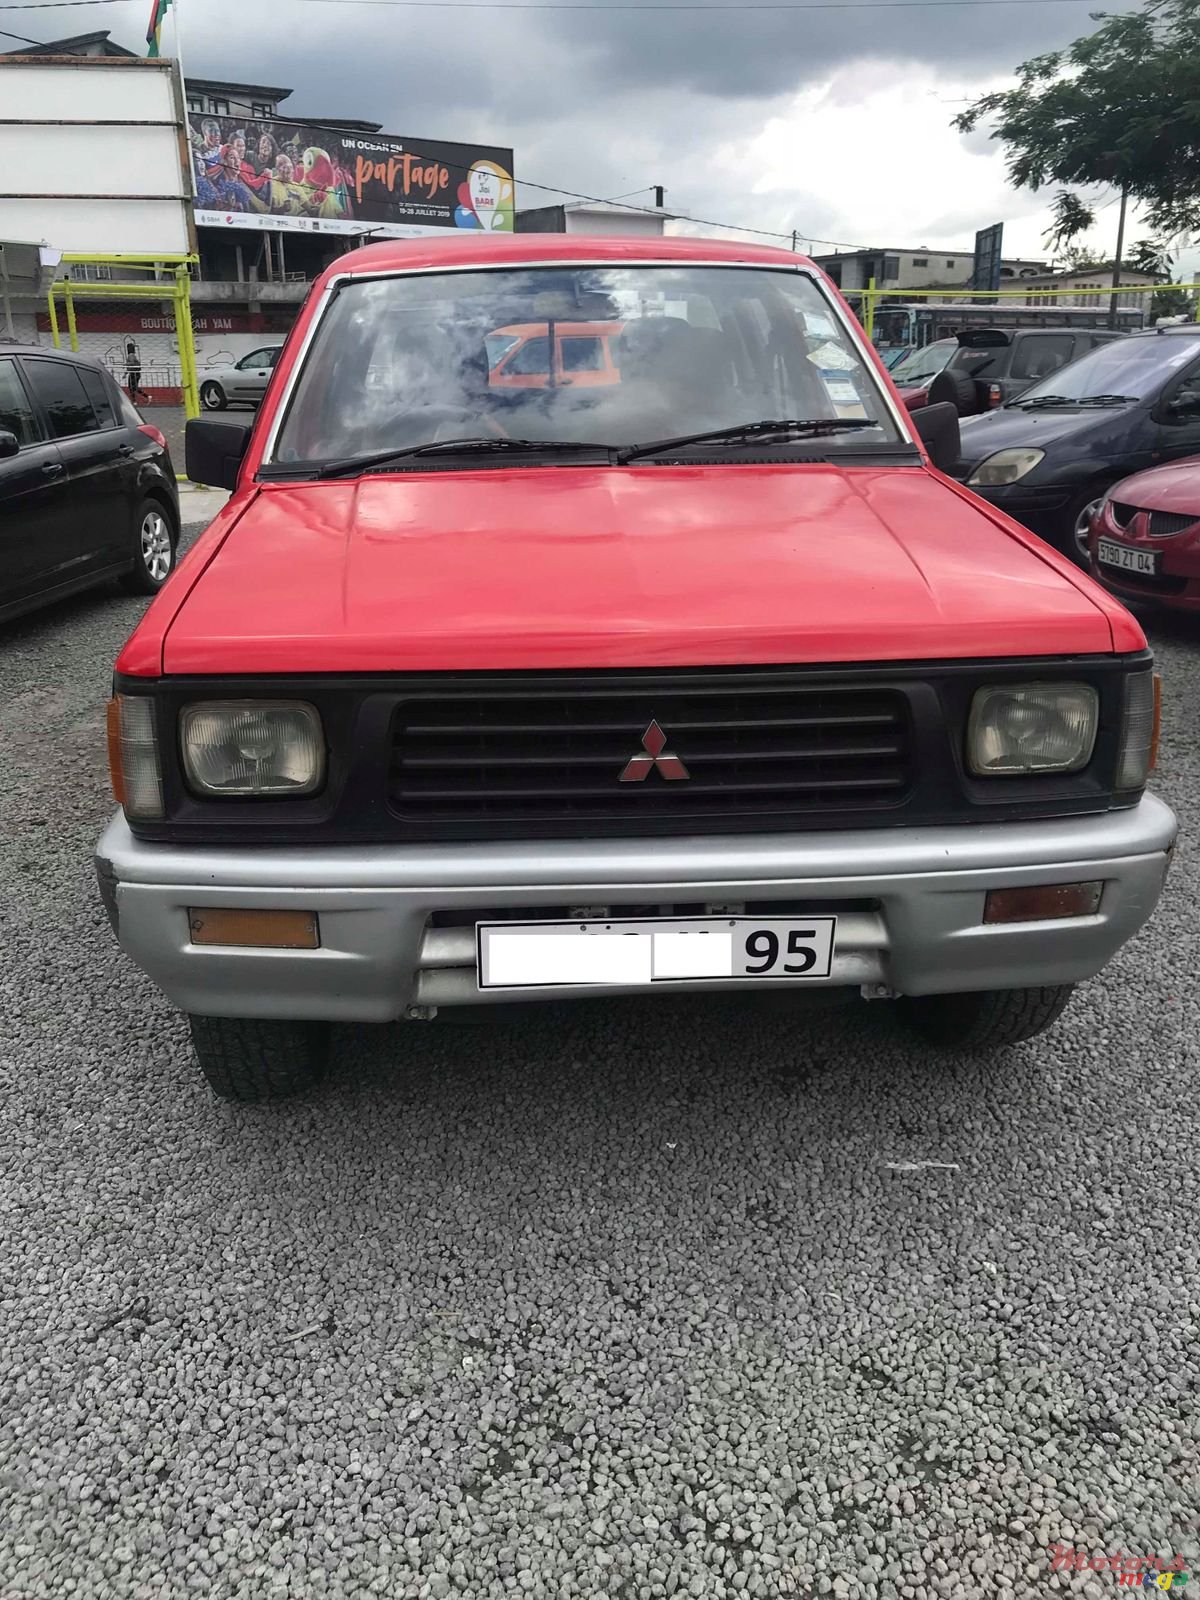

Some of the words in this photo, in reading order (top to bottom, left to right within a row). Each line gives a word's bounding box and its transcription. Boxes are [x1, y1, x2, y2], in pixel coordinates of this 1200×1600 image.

[341, 139, 355, 148] UN
[357, 140, 389, 152] OCEAN
[390, 144, 403, 153] EN
[141, 318, 176, 330] BOUTIQ
[212, 318, 232, 329] YAM
[1100, 544, 1120, 564] 5790
[1122, 550, 1134, 568] ZT
[1138, 554, 1151, 571] 04
[745, 930, 817, 974] 95
